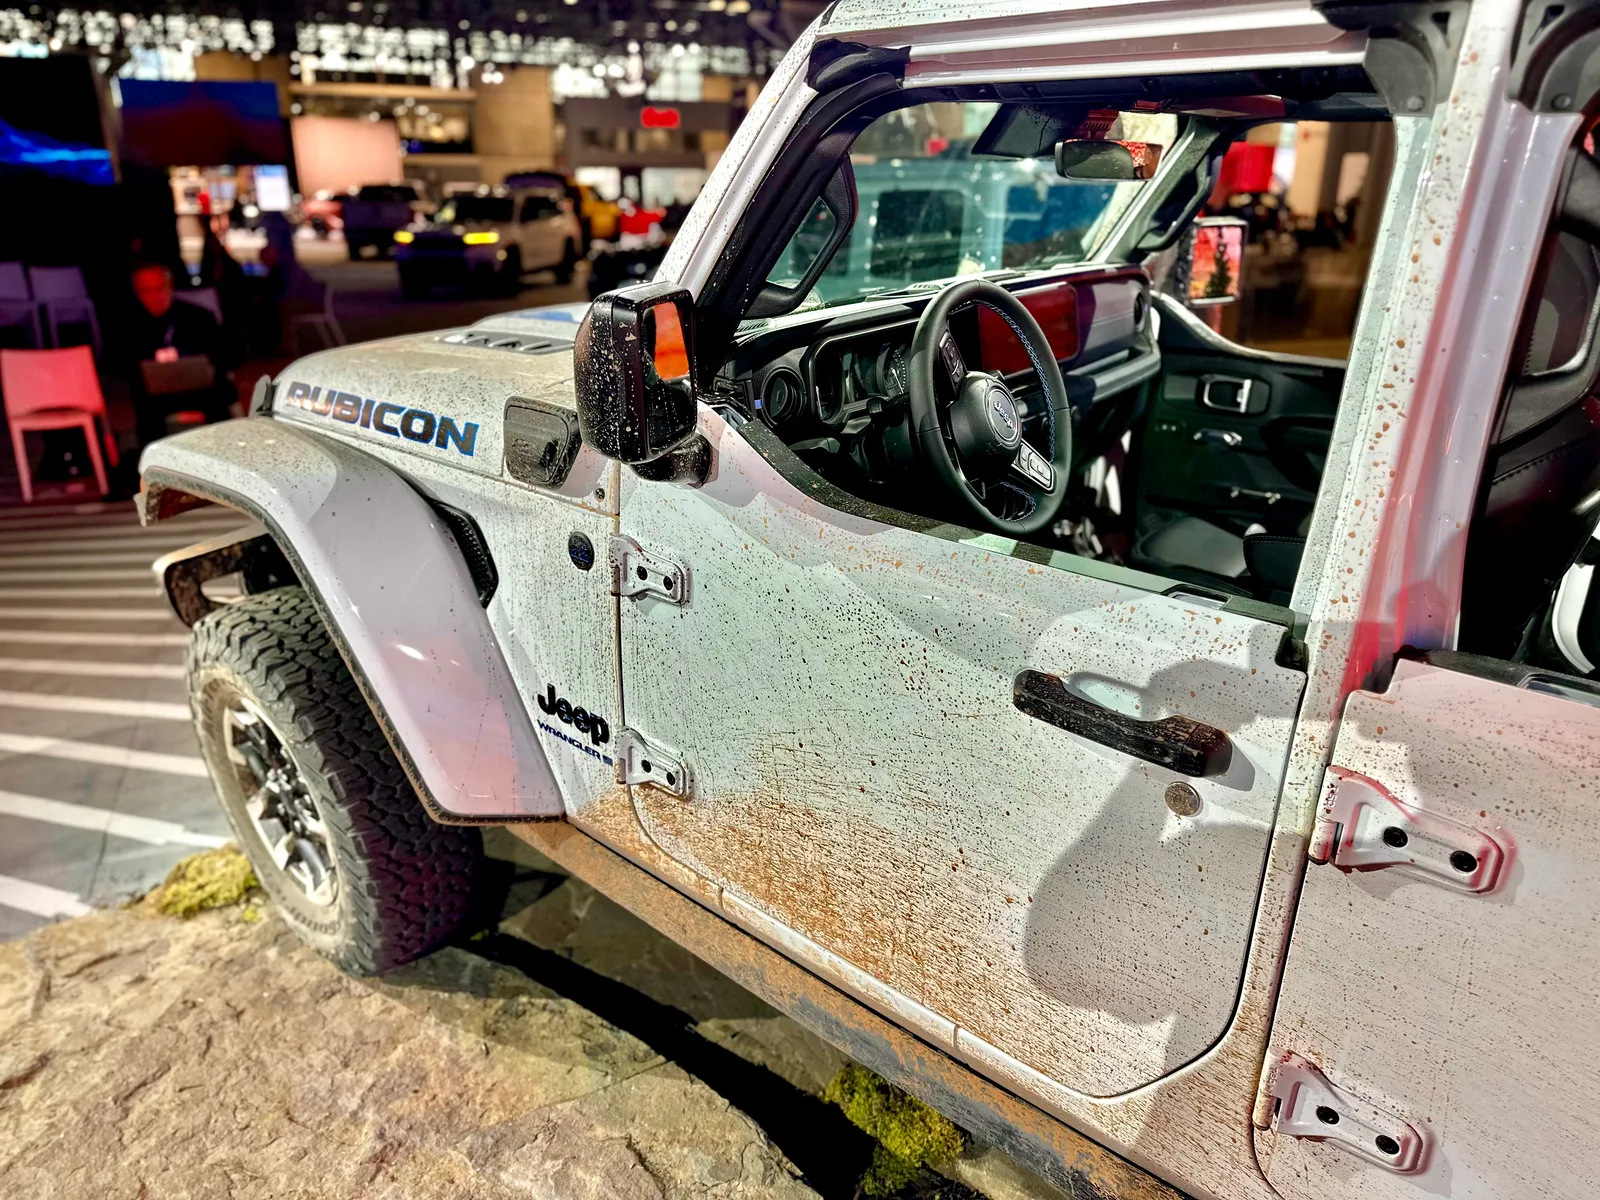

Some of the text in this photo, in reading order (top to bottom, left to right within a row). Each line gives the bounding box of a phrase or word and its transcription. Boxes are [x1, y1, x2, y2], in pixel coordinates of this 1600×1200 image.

[286, 381, 480, 457] RUBICON
[537, 682, 610, 747] Jeep
[537, 719, 602, 761] WRANGLER
